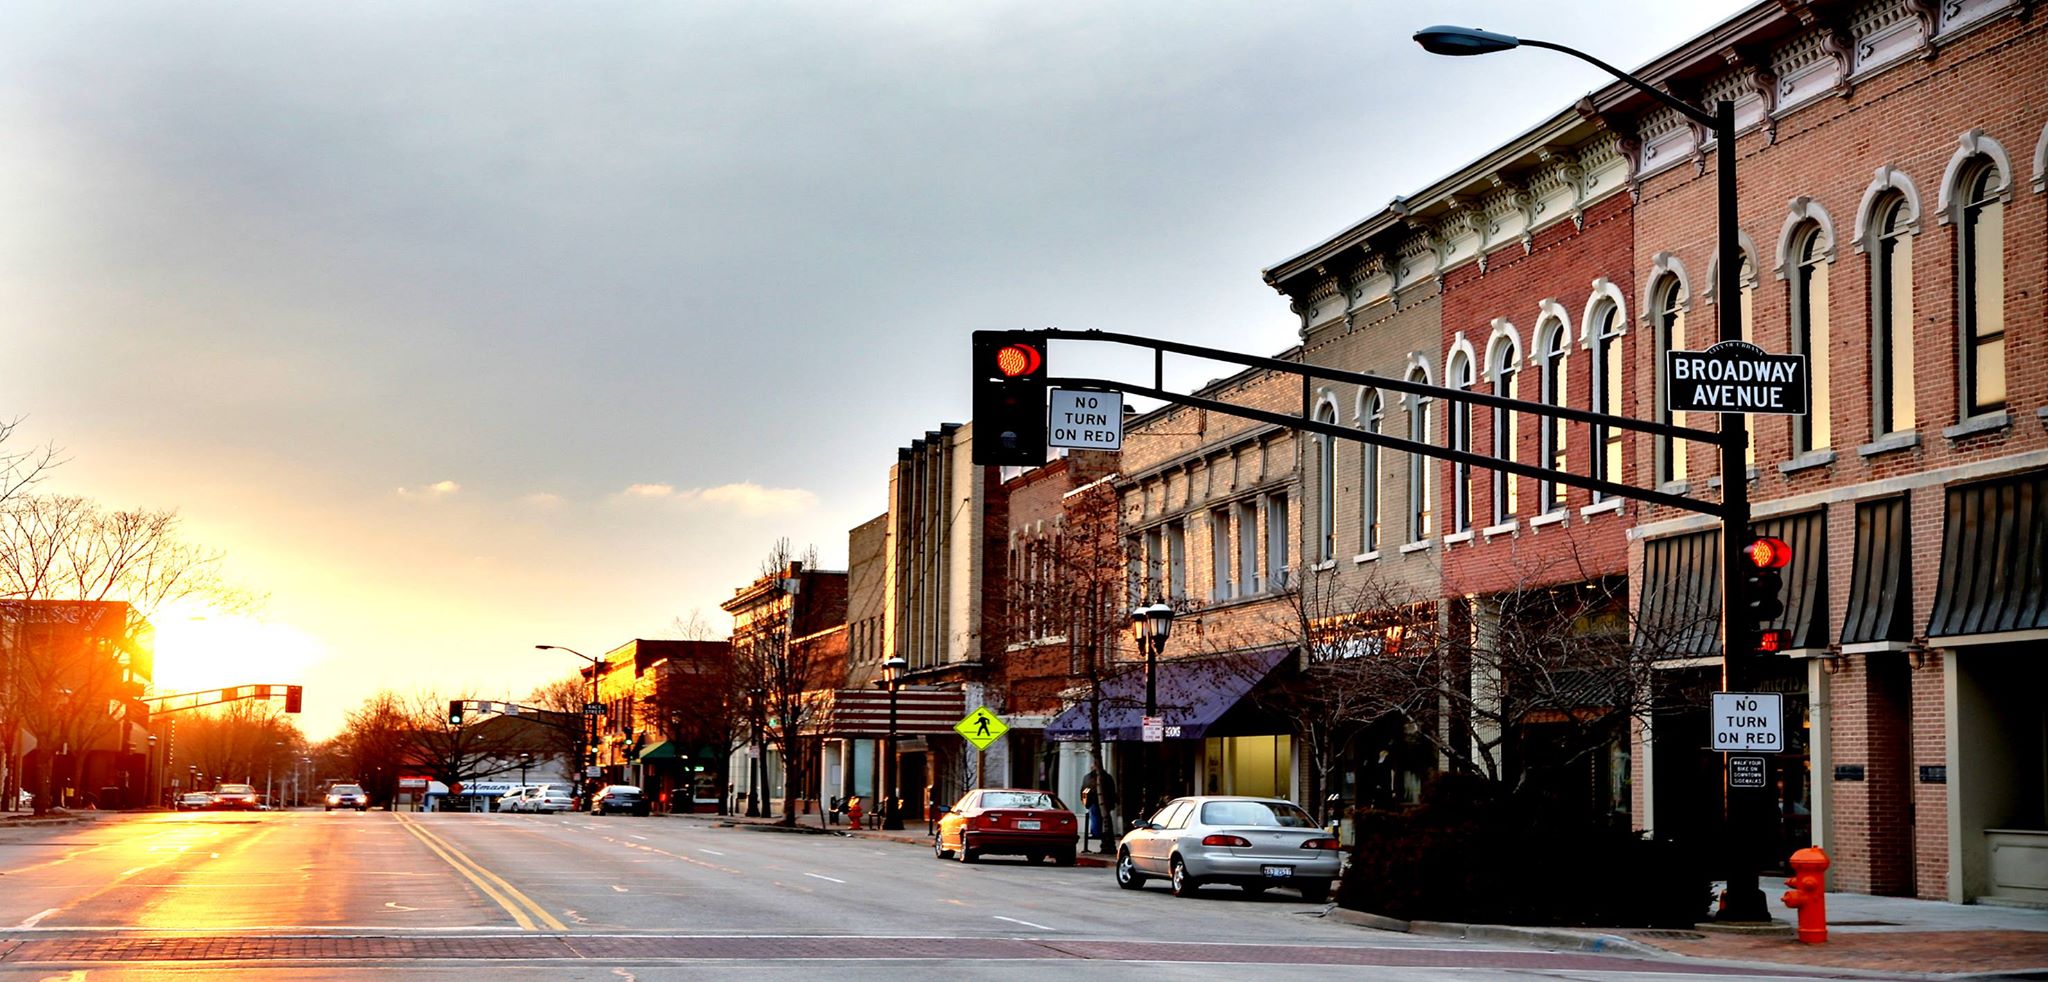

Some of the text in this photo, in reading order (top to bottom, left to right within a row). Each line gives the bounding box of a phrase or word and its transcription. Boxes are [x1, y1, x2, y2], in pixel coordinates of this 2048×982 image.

[1675, 358, 1797, 383] BROADWAY
[1075, 397, 1098, 409] NO
[1692, 385, 1783, 408] AVENUE
[1065, 412, 1107, 426] TURN
[1055, 428, 1115, 443] ON RED
[1736, 700, 1757, 712] NO
[1726, 716, 1767, 728] TURN
[1718, 732, 1776, 744] ON RED
